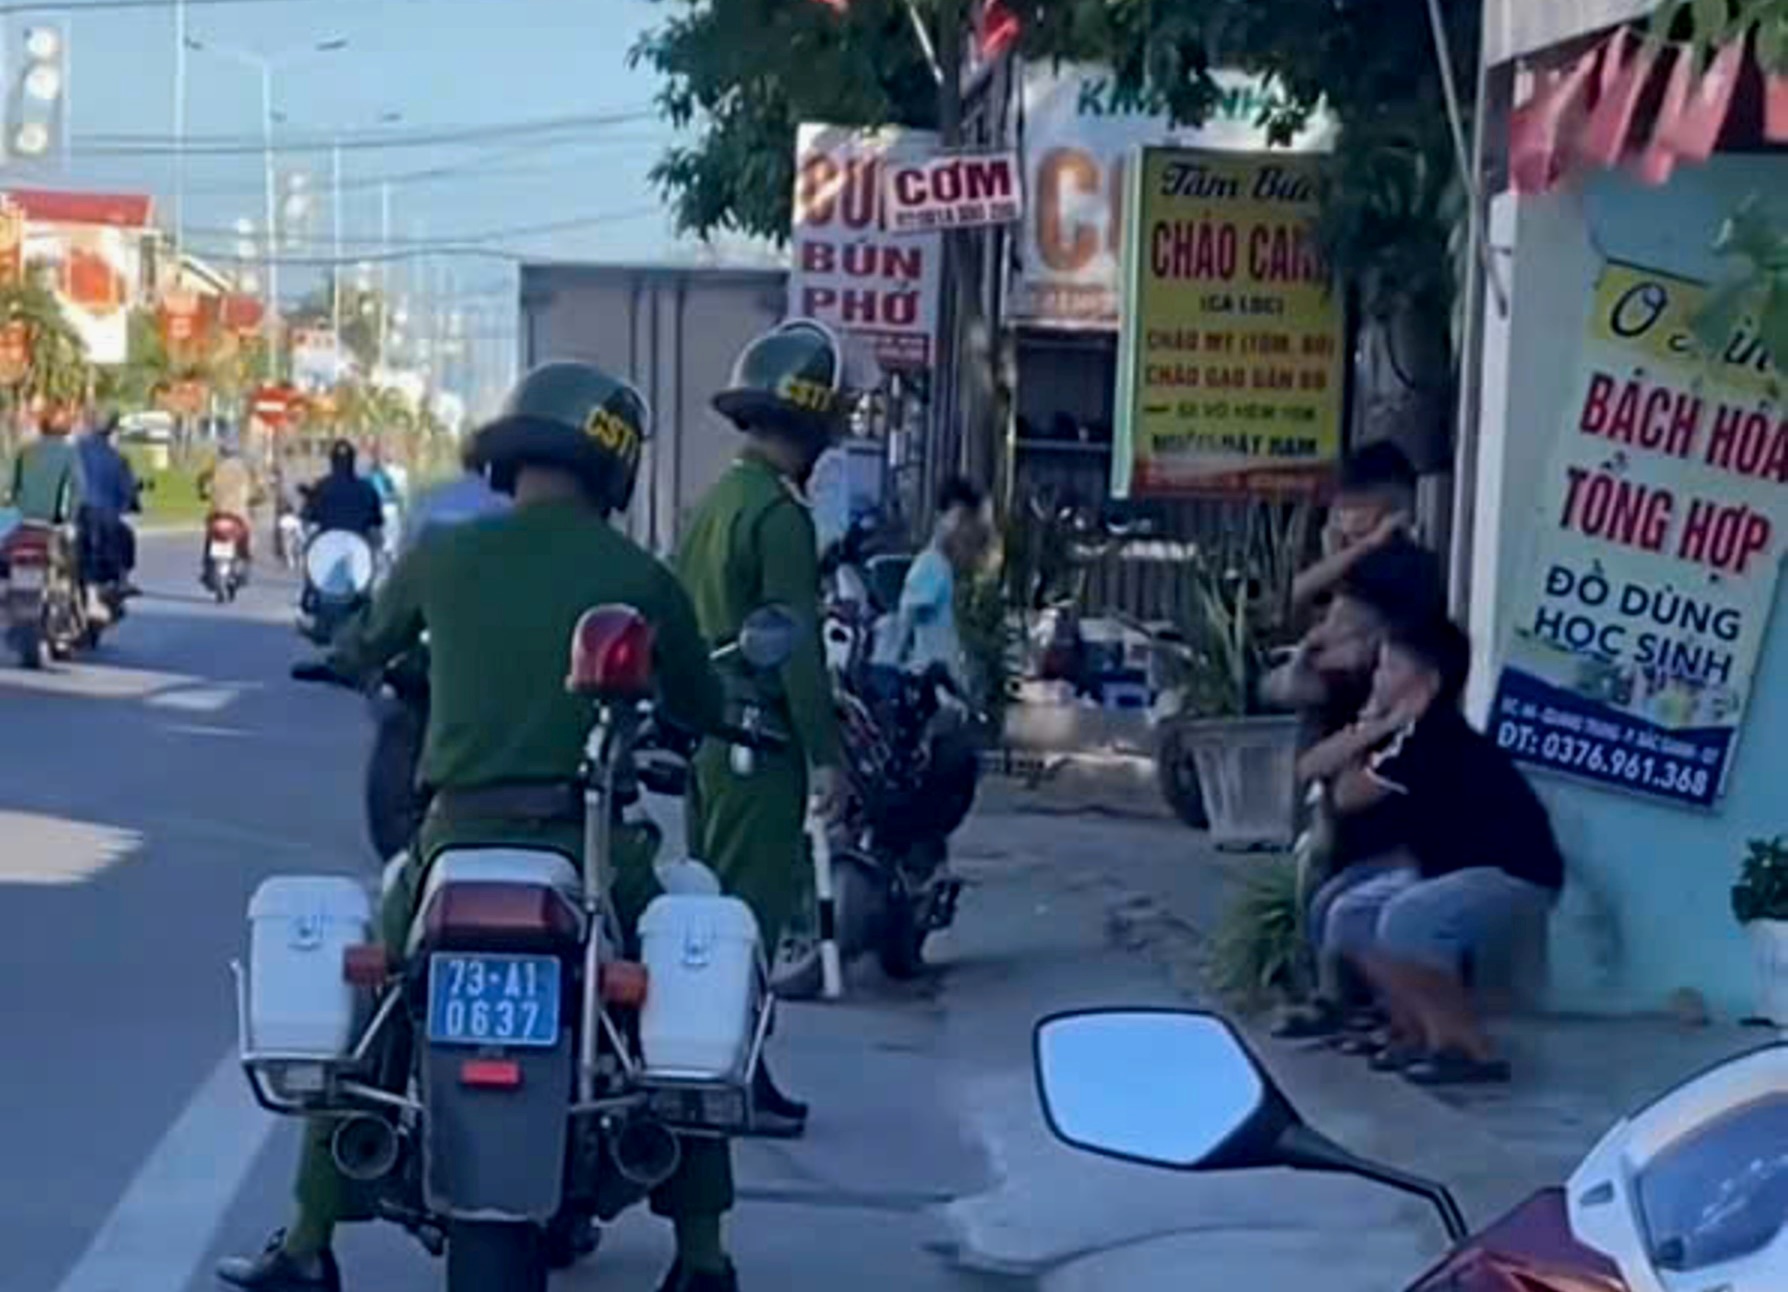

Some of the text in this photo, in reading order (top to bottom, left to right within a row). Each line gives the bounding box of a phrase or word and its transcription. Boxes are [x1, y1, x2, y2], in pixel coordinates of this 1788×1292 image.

[895, 160, 1010, 206] CƠM
[802, 237, 922, 280] BÚN
[1151, 209, 1237, 280] CHÁO
[802, 281, 920, 325] PHỞ
[1580, 366, 1702, 459] BÁCH
[1560, 451, 1771, 583] TỔNG HỢP
[1545, 557, 1741, 641] ĐỒ DÙNG
[1534, 605, 1733, 684] HỌC SINH
[1541, 732, 1709, 796] 0376.961.368
[446, 999, 539, 1037] 0637
